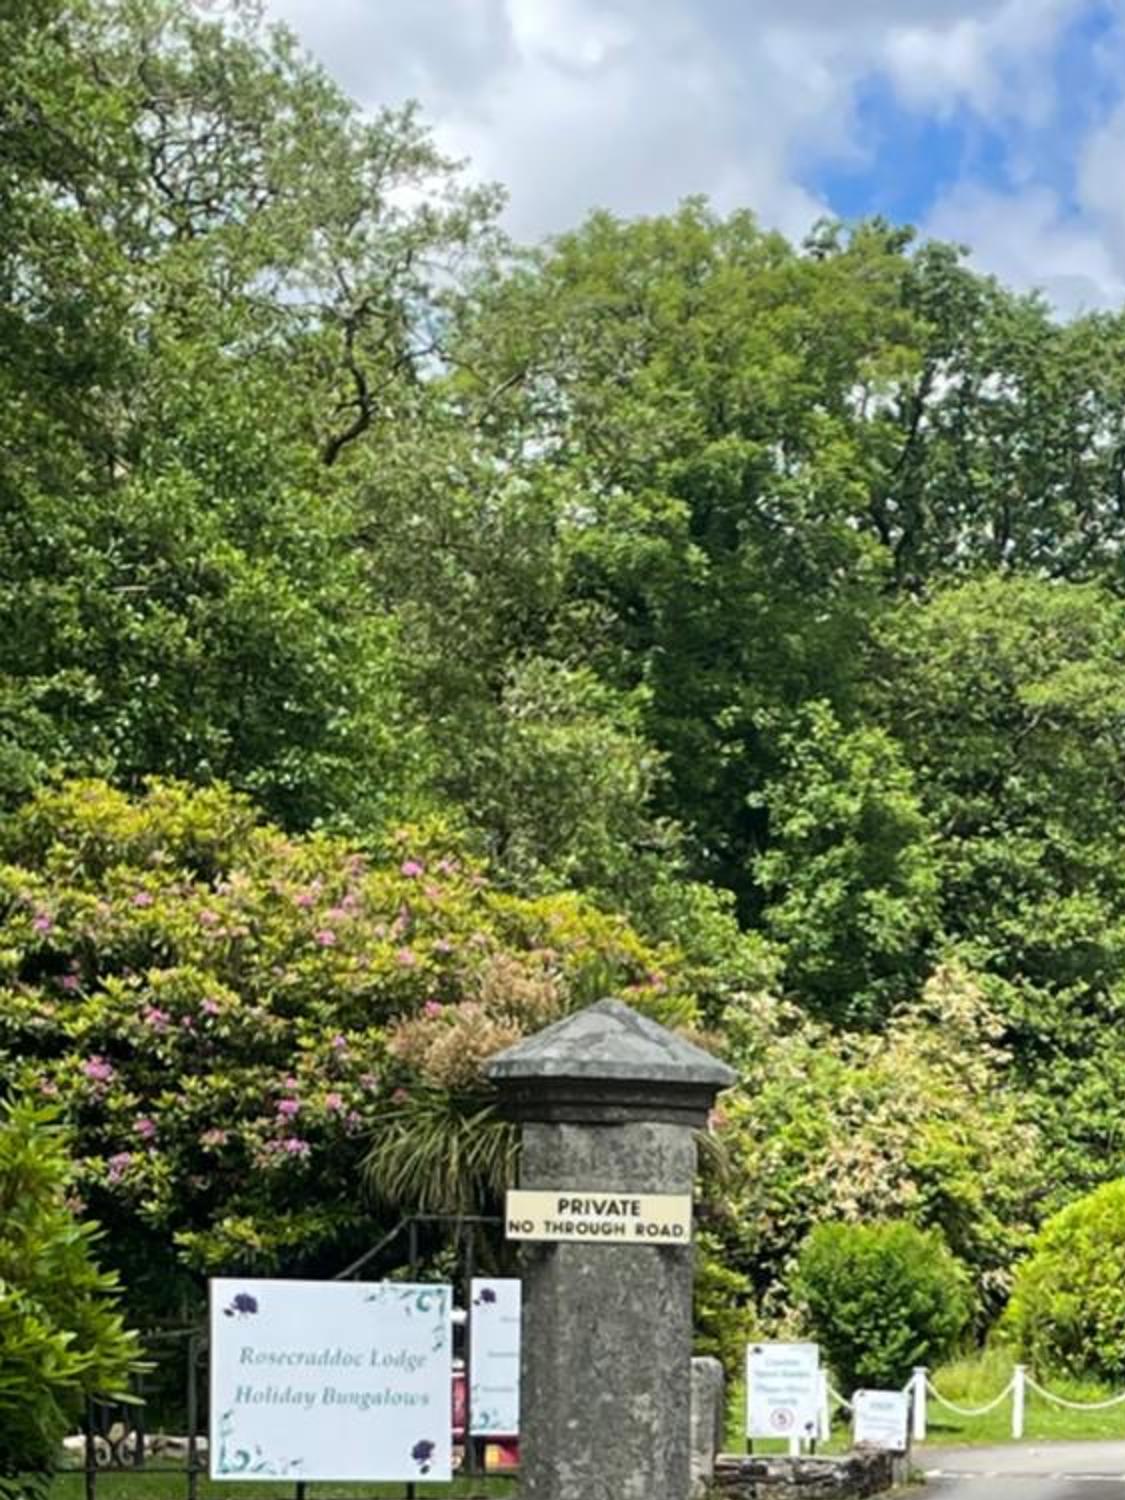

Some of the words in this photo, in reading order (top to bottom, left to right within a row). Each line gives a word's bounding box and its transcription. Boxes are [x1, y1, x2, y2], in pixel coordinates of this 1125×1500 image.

[558, 1198, 640, 1216] PRIVATE
[509, 1220, 534, 1233] NO
[544, 1220, 625, 1235] THROUGH
[636, 1223, 683, 1237] ROAD
[239, 1346, 361, 1367] Rosecraddoc
[369, 1348, 427, 1372] Lodge
[235, 1385, 316, 1409] Holiday
[321, 1386, 430, 1411] Bungalows
